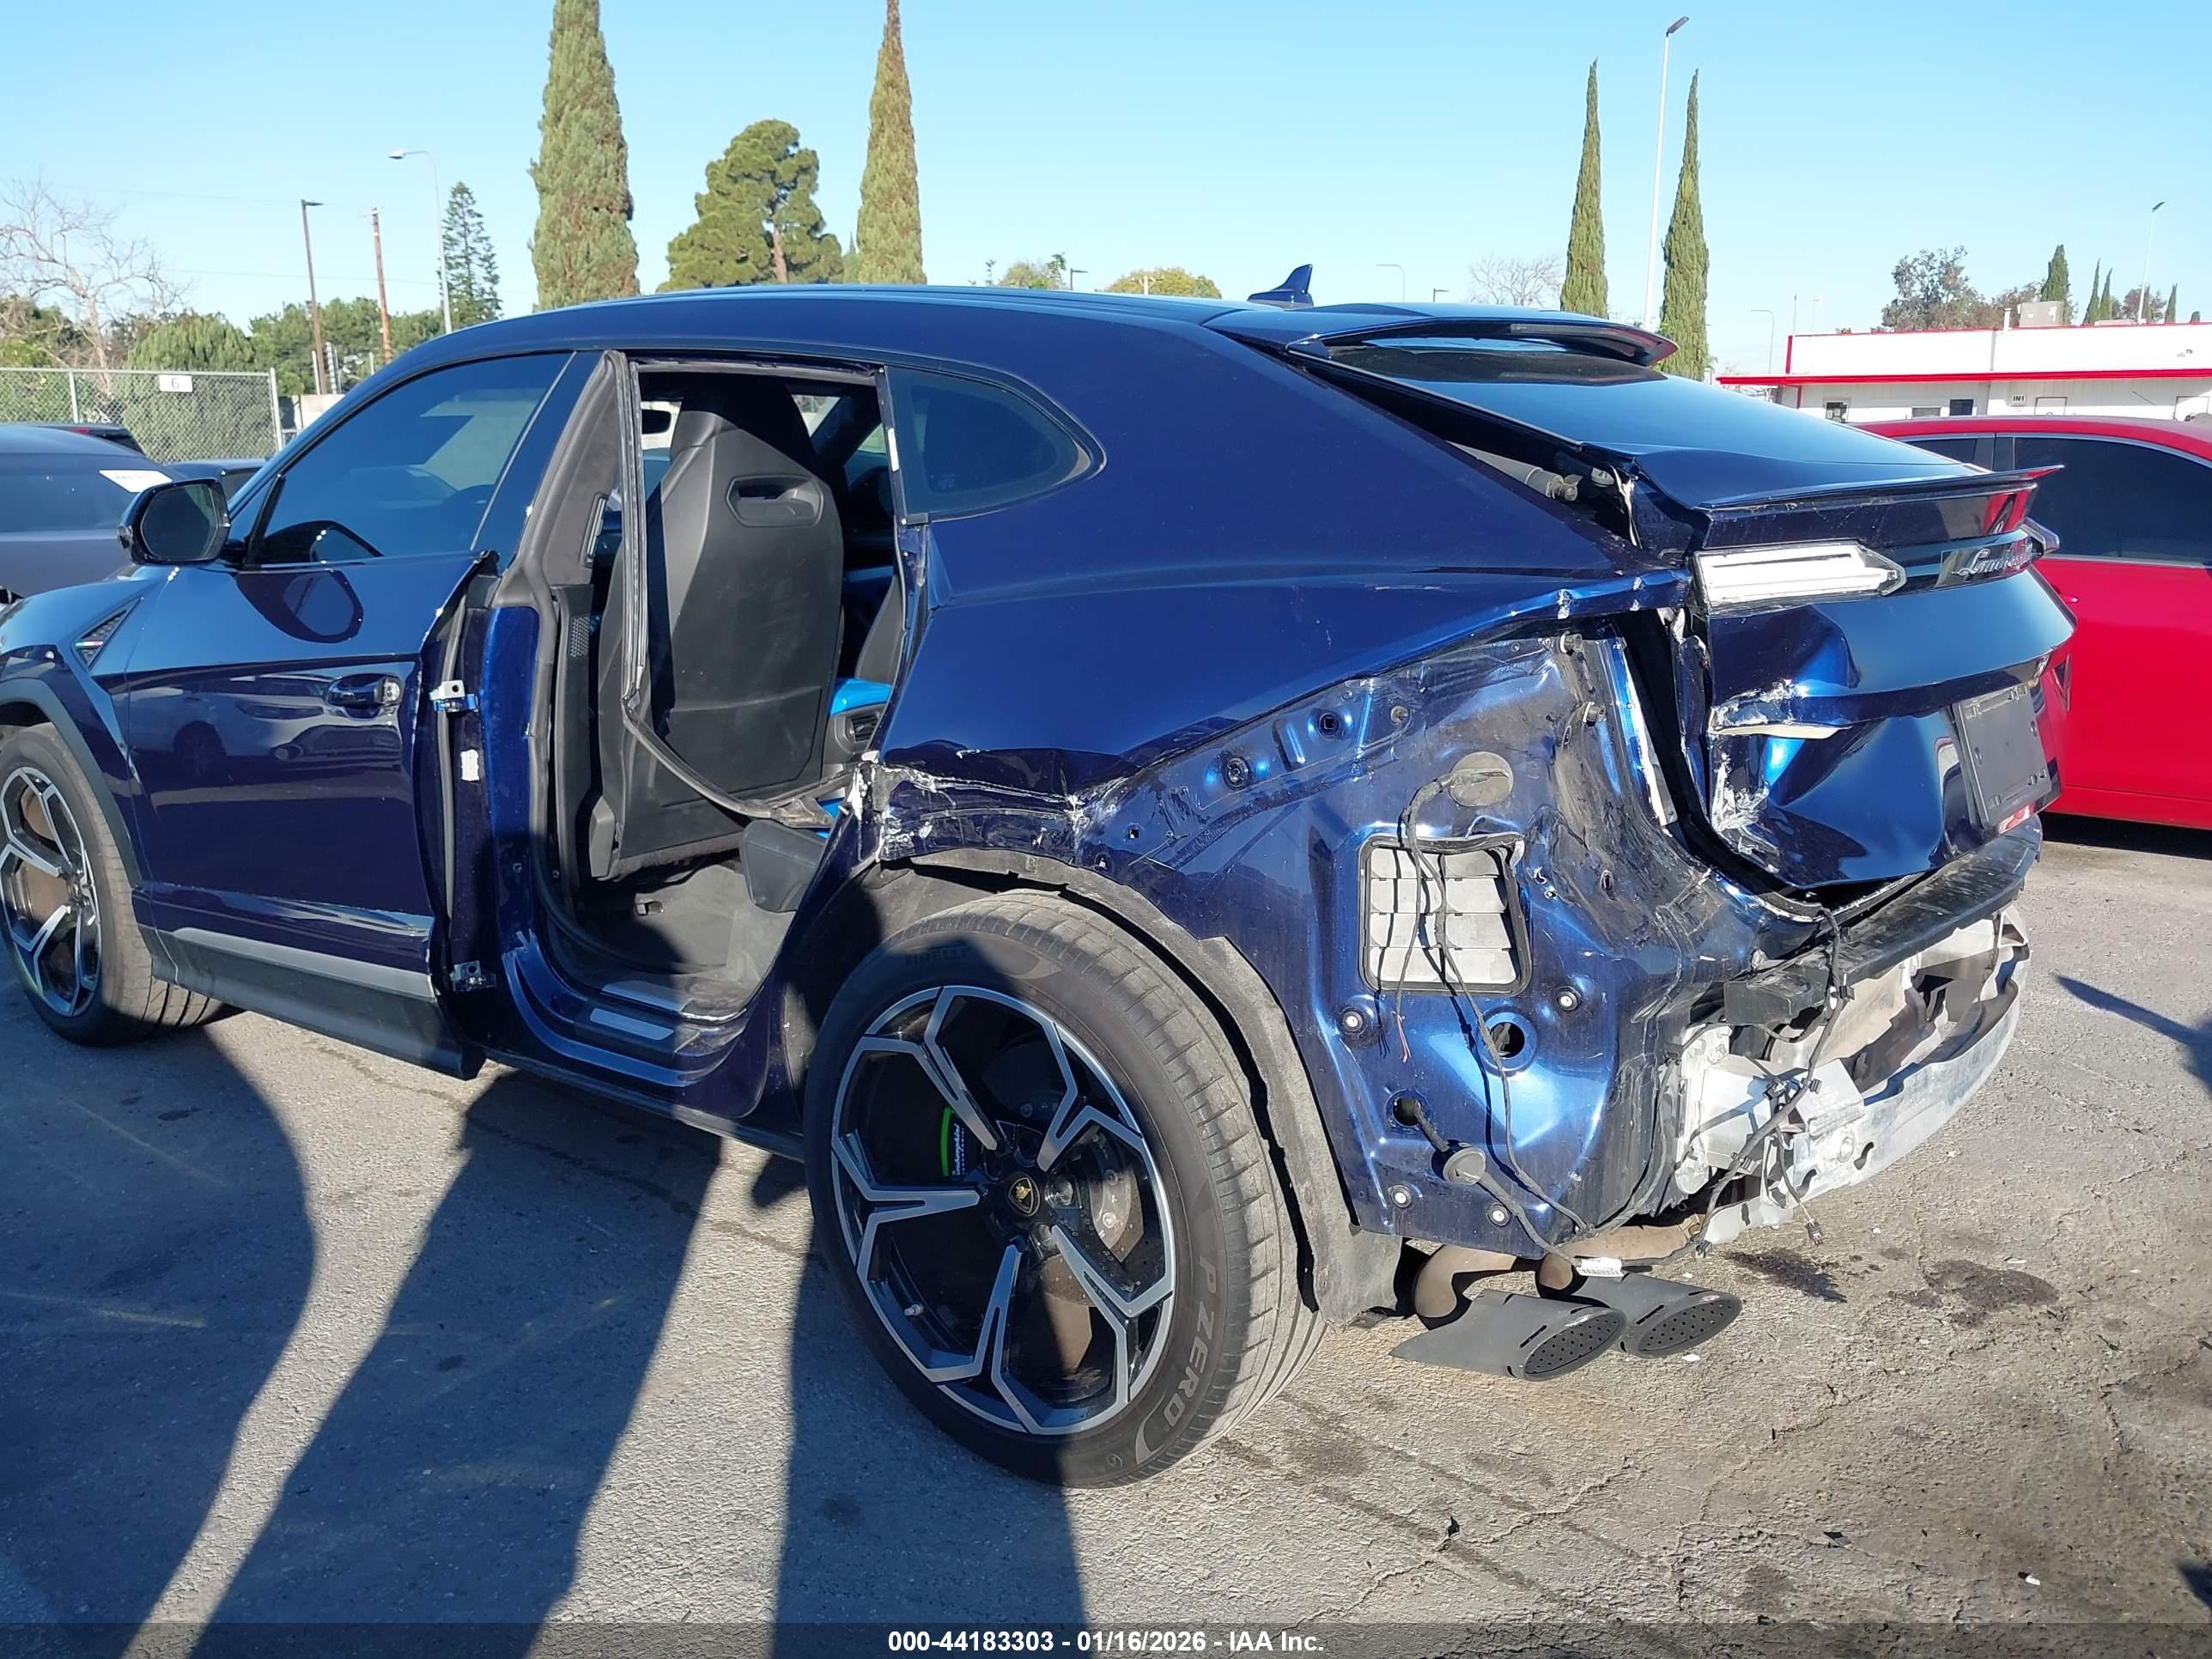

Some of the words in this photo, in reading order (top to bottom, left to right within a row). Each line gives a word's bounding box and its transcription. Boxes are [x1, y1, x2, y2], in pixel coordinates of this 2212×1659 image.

[172, 378, 179, 389] 6
[1200, 1256, 1217, 1293] P
[1164, 1301, 1215, 1427] ZERO
